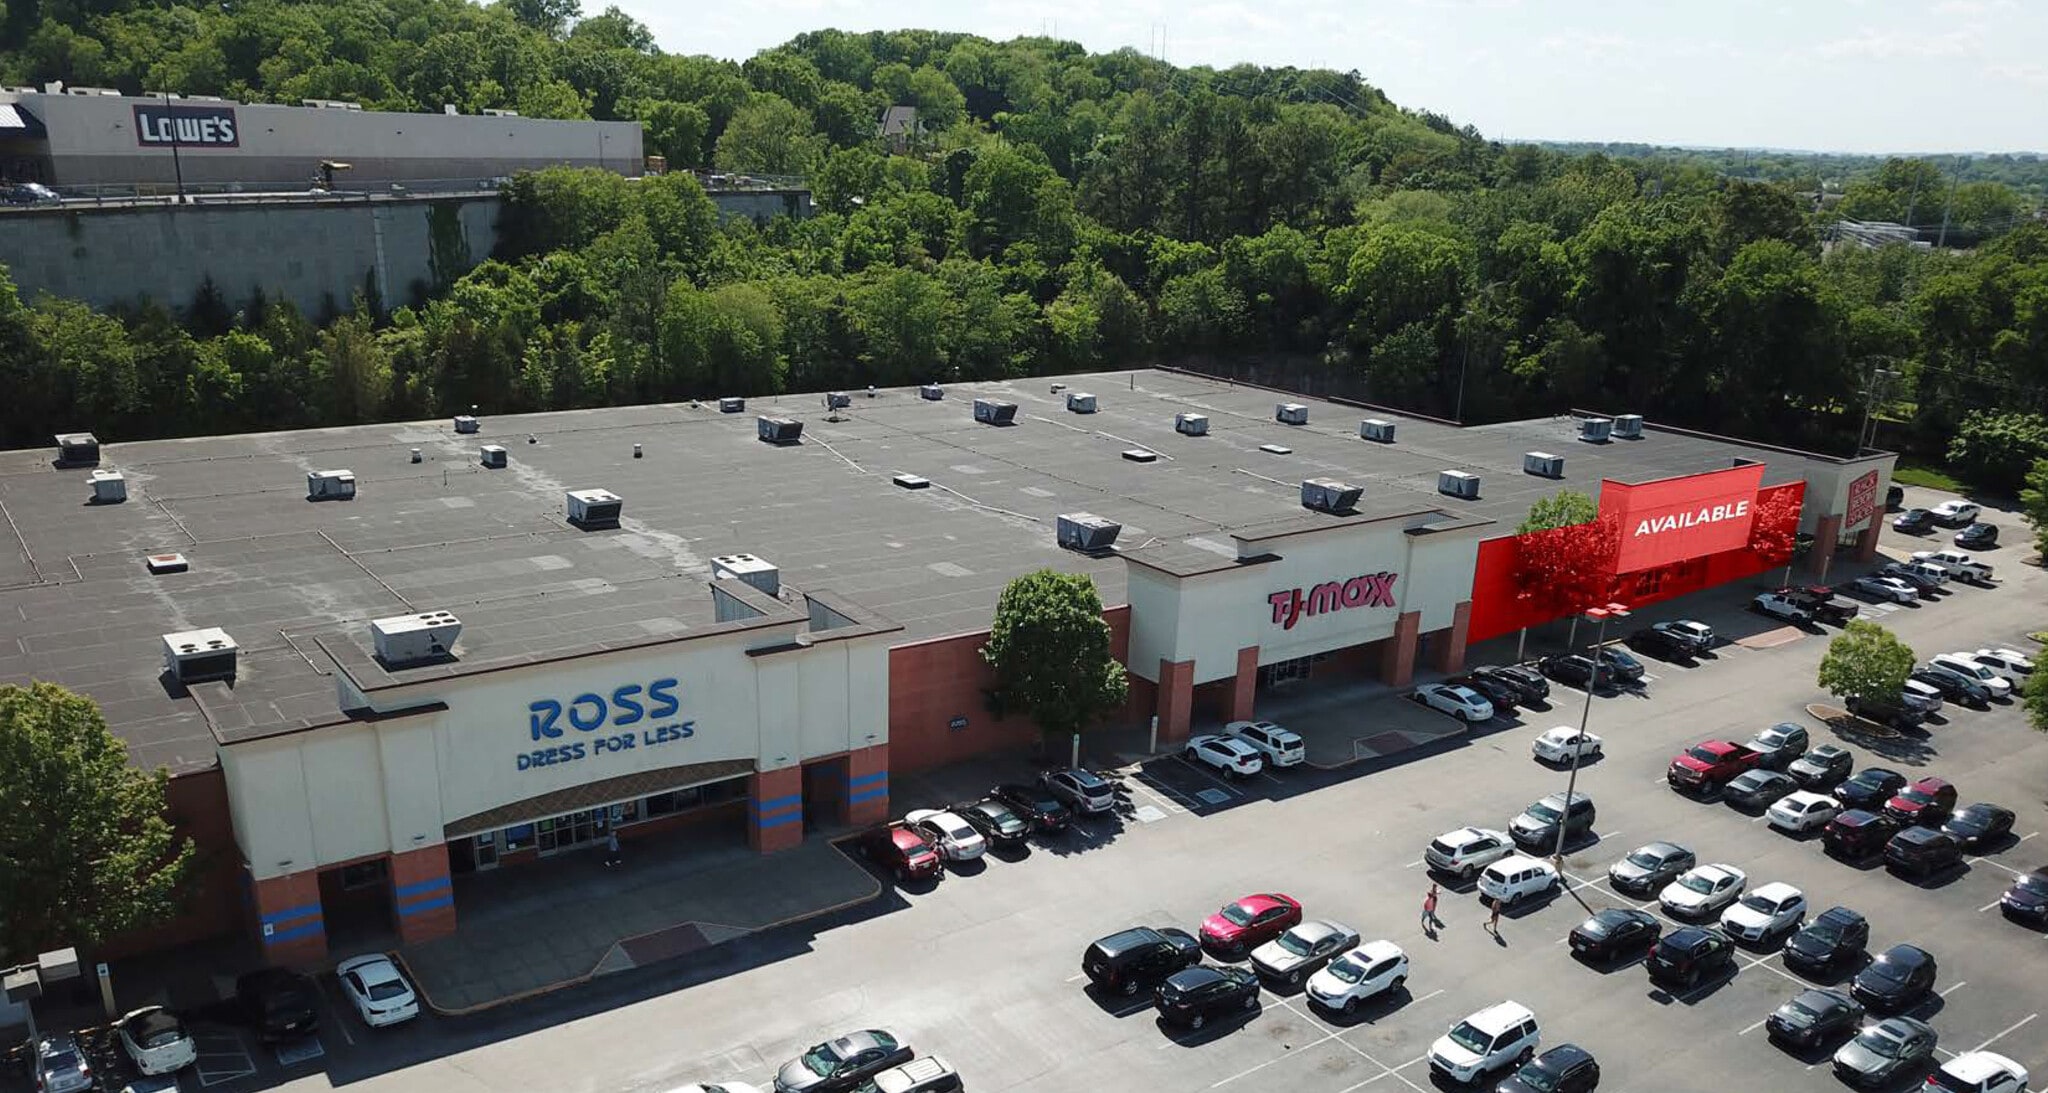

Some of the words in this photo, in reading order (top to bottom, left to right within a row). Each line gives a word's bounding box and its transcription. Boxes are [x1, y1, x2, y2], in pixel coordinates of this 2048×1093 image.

[140, 113, 234, 142] LOWE'S
[529, 678, 680, 741] ROSS
[517, 743, 585, 770] DRESS
[594, 733, 636, 755] FOR
[644, 721, 695, 746] LESS
